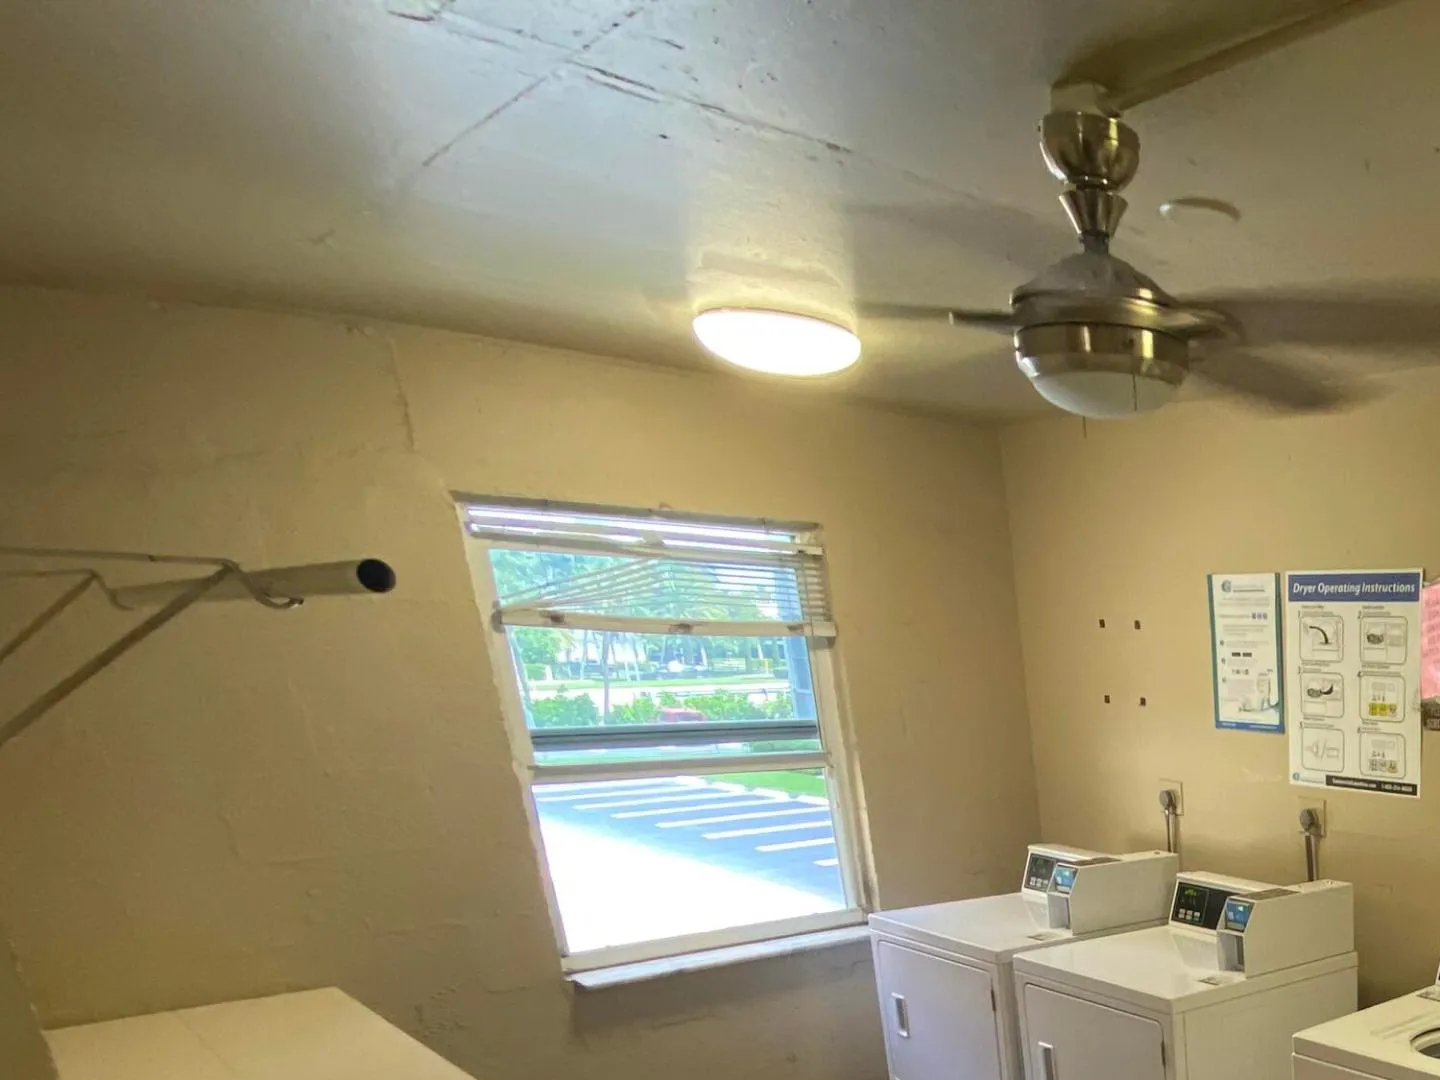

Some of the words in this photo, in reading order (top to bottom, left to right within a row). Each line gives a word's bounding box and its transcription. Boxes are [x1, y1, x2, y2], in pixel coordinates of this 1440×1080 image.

[1293, 583, 1316, 596] Dryer
[1317, 582, 1361, 596] Operating
[1362, 582, 1415, 594] Instructions
